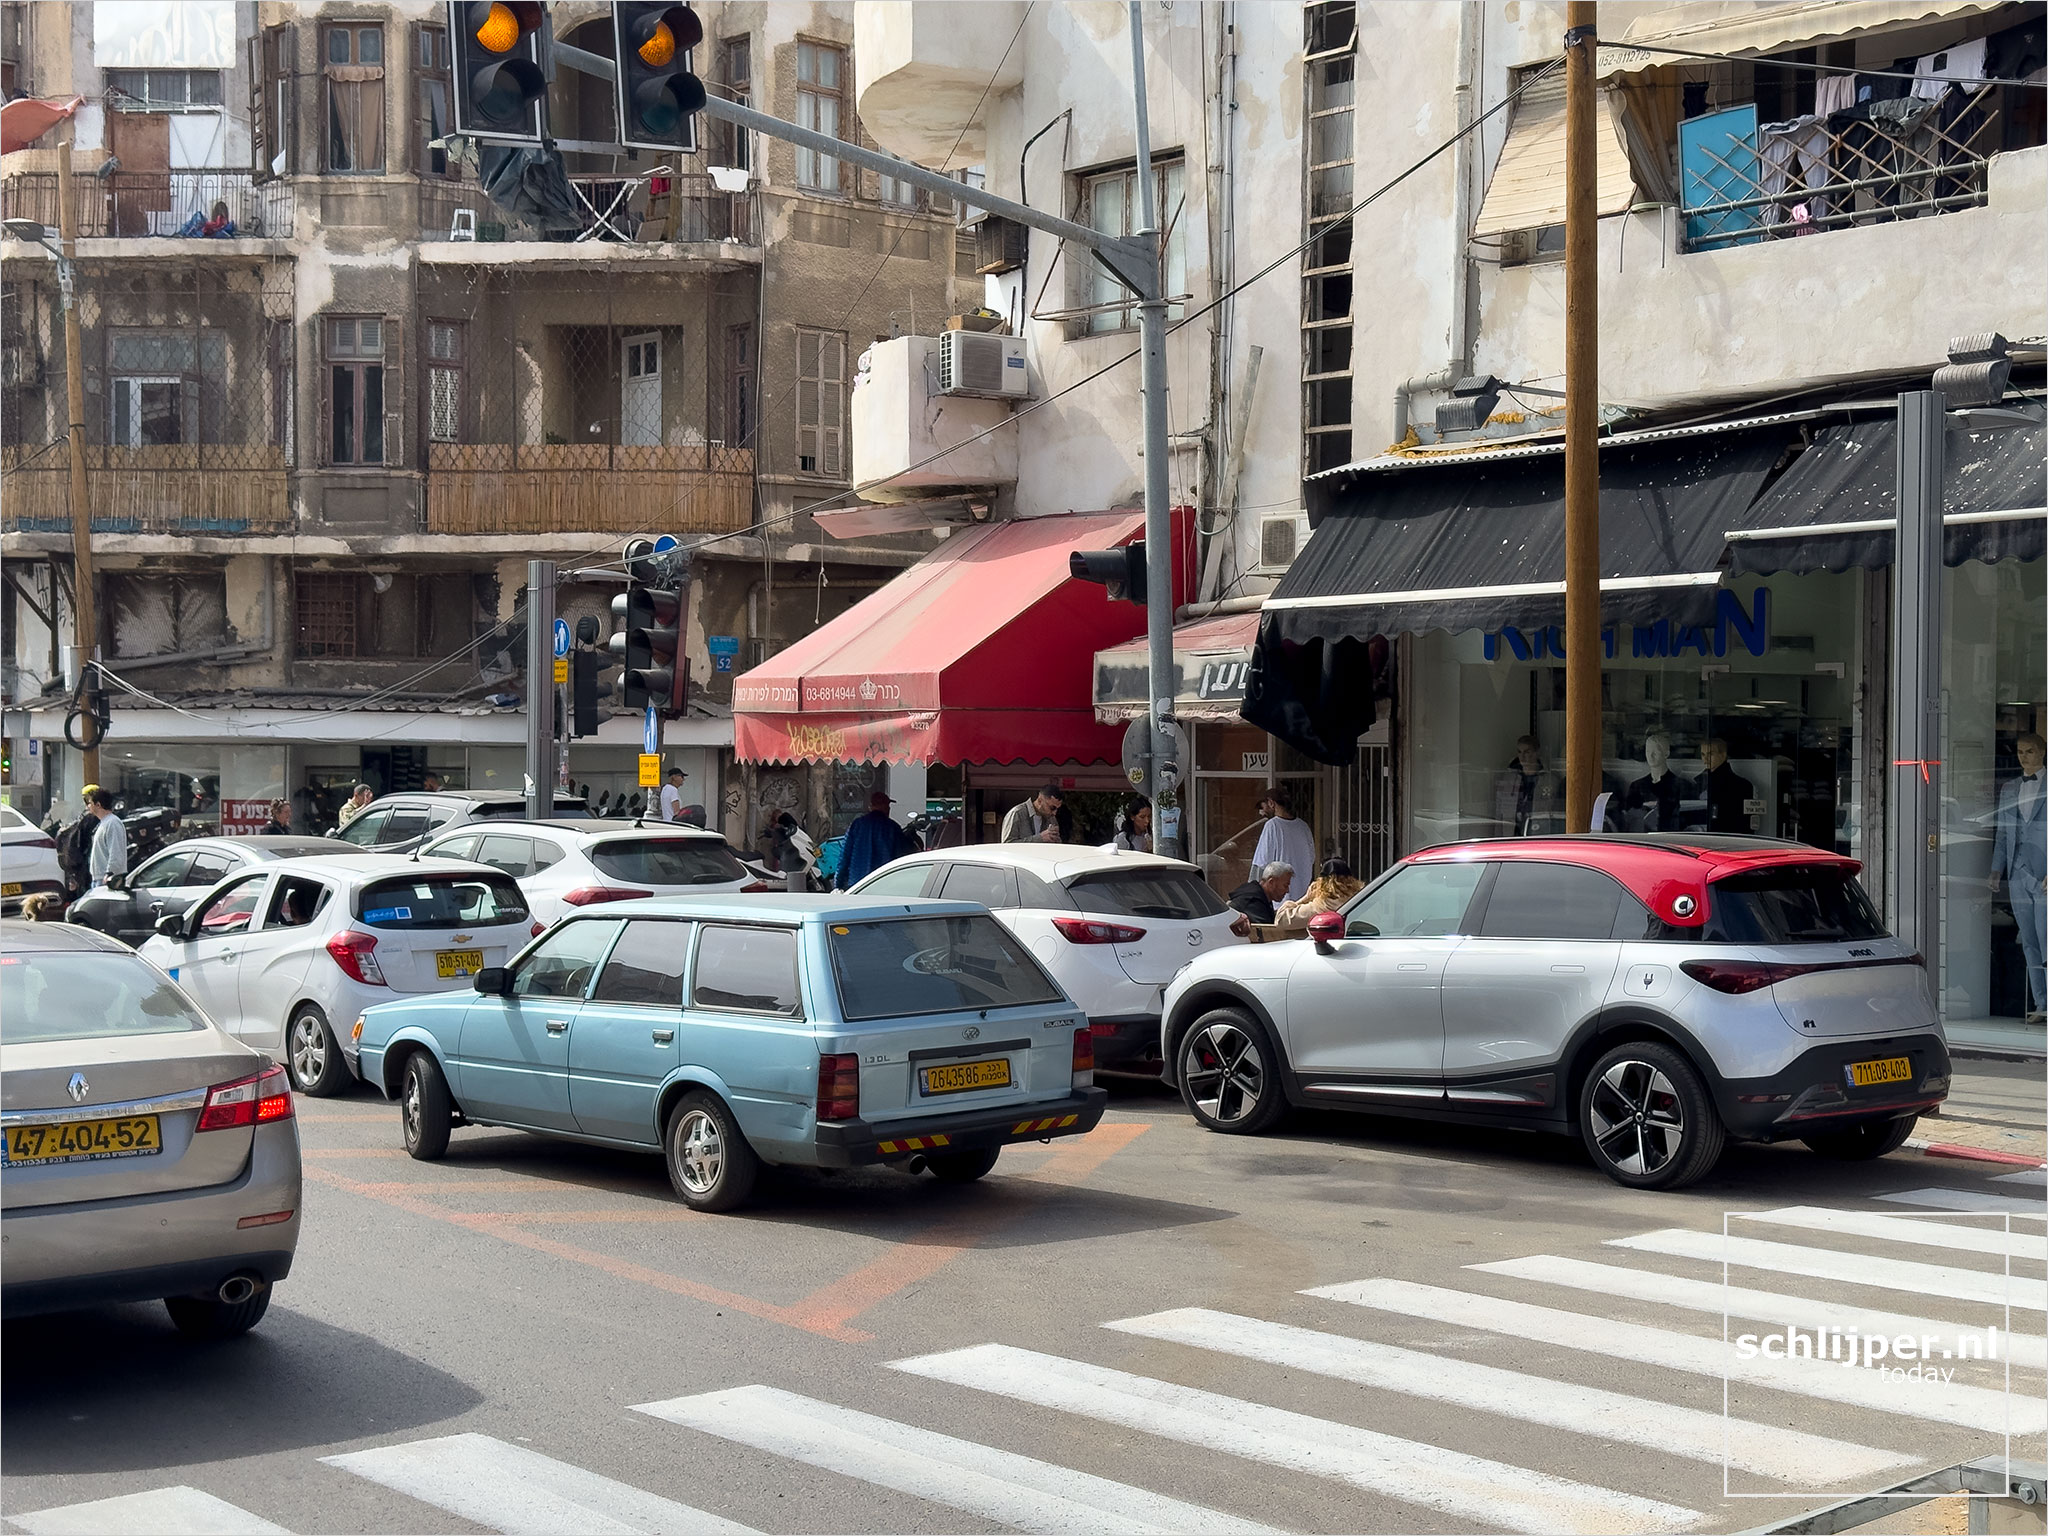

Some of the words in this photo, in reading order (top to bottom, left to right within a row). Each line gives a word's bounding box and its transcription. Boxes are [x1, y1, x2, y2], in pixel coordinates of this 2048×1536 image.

[717, 658, 731, 669] 52
[771, 687, 799, 702] המרכז
[806, 686, 856, 701] 03-6814944
[877, 684, 901, 700] כתר
[1243, 752, 1269, 770] שען
[232, 803, 273, 819] בצעים
